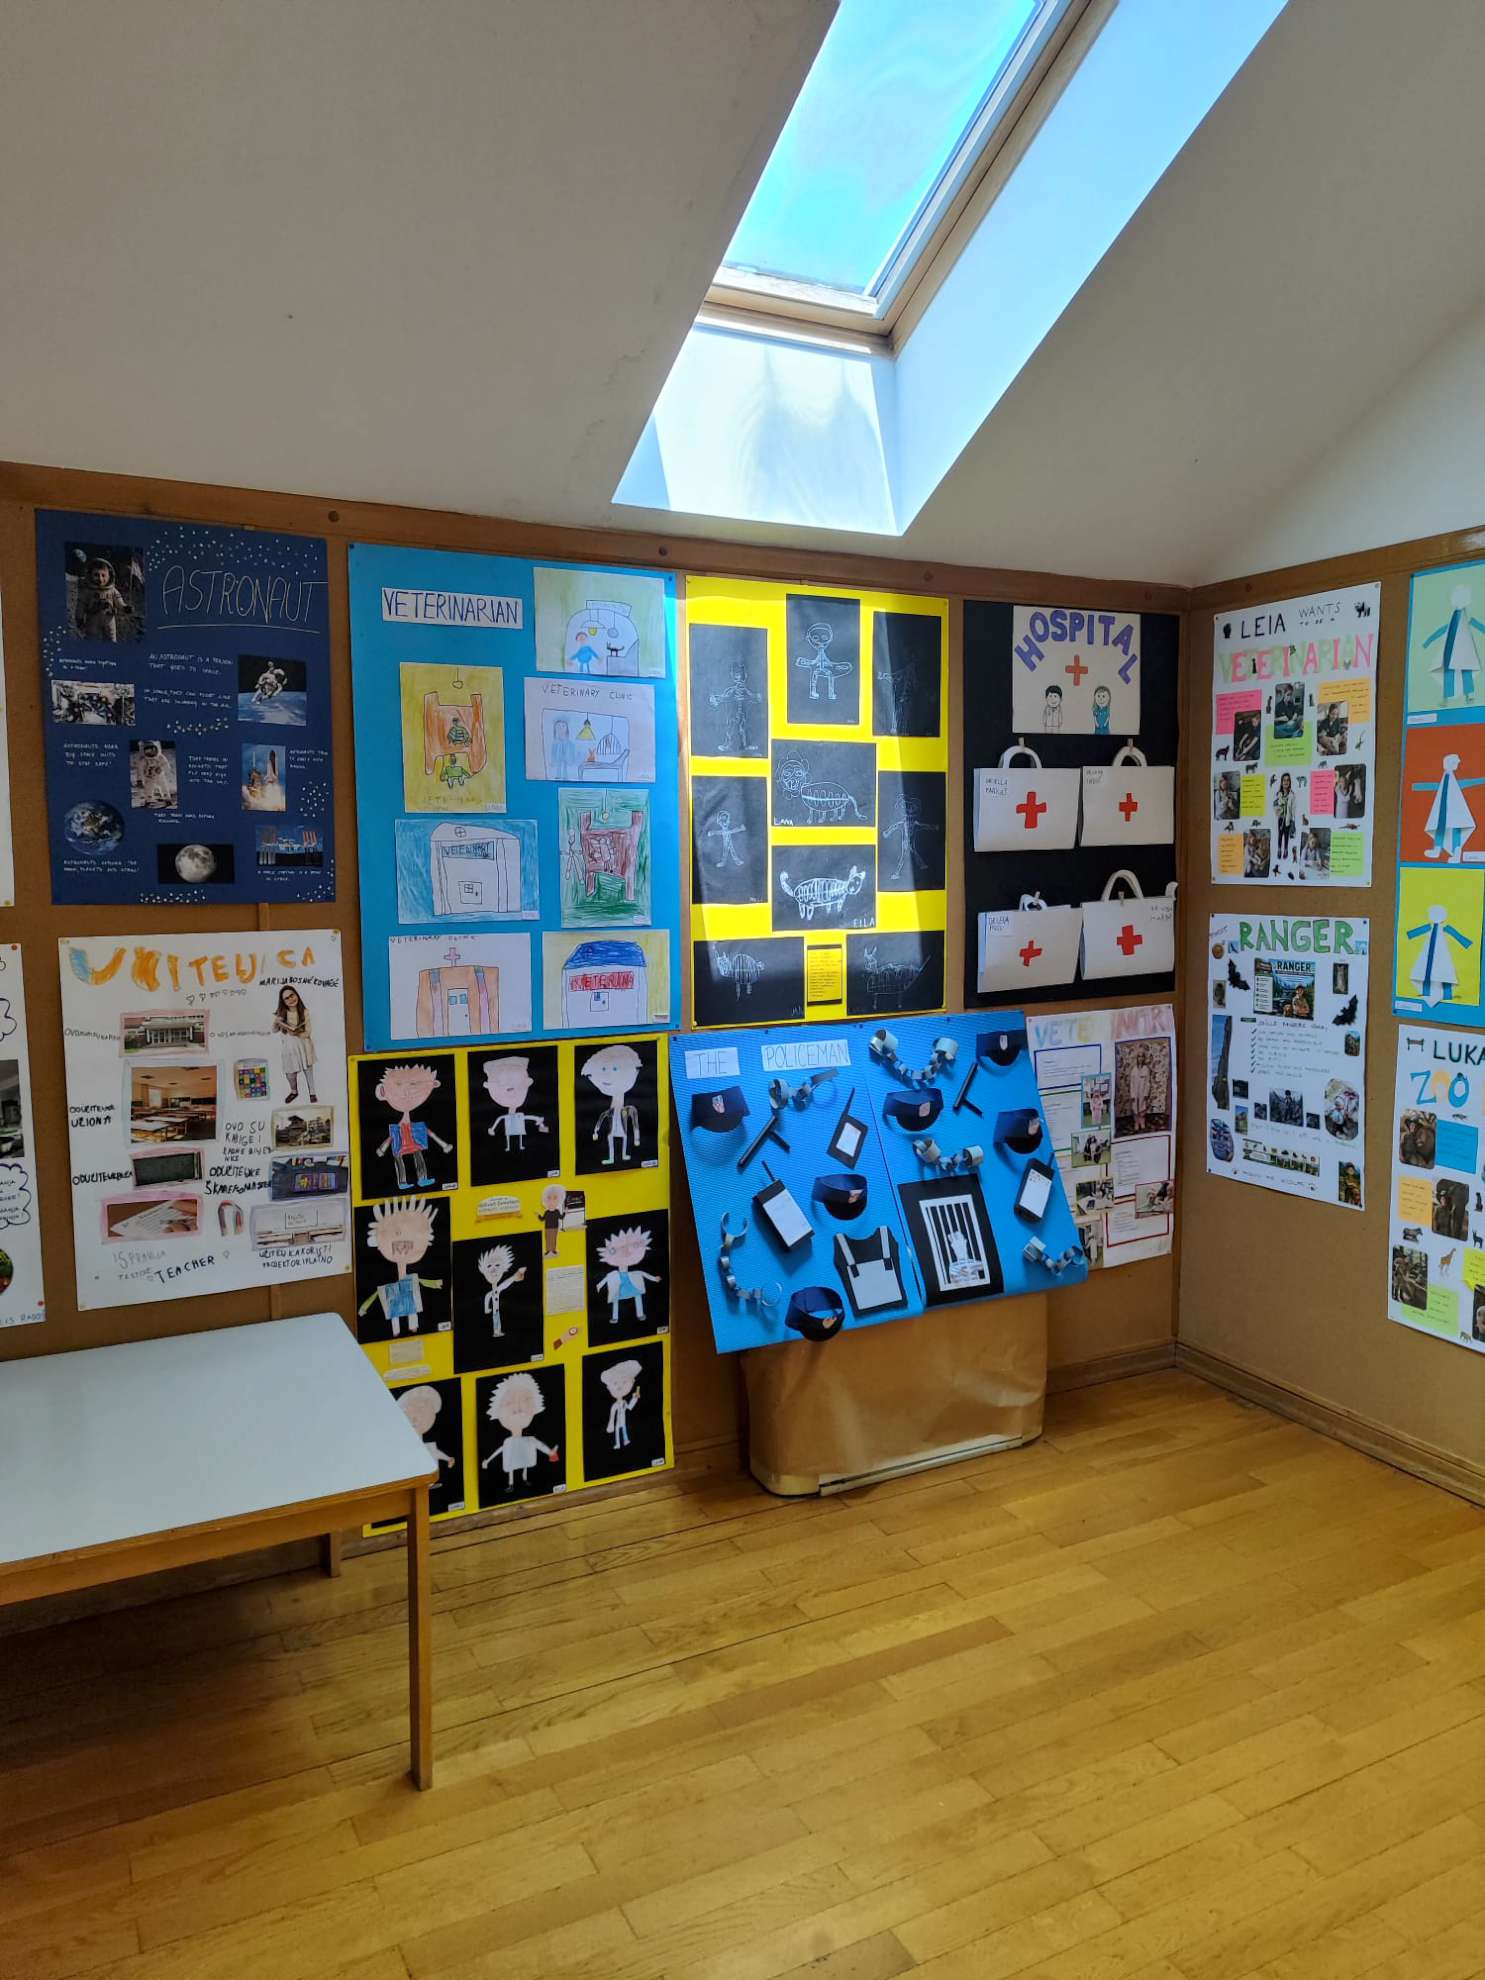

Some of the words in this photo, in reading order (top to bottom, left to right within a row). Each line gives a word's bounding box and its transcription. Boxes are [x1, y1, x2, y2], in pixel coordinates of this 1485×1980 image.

[161, 564, 328, 624] ASTRONAUT
[383, 589, 519, 625] VETERINARIAN
[1241, 613, 1286, 639] LEIA
[1298, 602, 1341, 618] WANTS
[1014, 609, 1138, 685] HOSPITAL
[1239, 919, 1356, 957] RANGER
[1277, 961, 1312, 973] RANGER
[691, 1051, 728, 1077] THE
[765, 1044, 849, 1067] POLICEMAN
[1410, 1070, 1470, 1108] ZOO
[249, 1120, 265, 1134] SU
[155, 1255, 216, 1284] TEACHER
